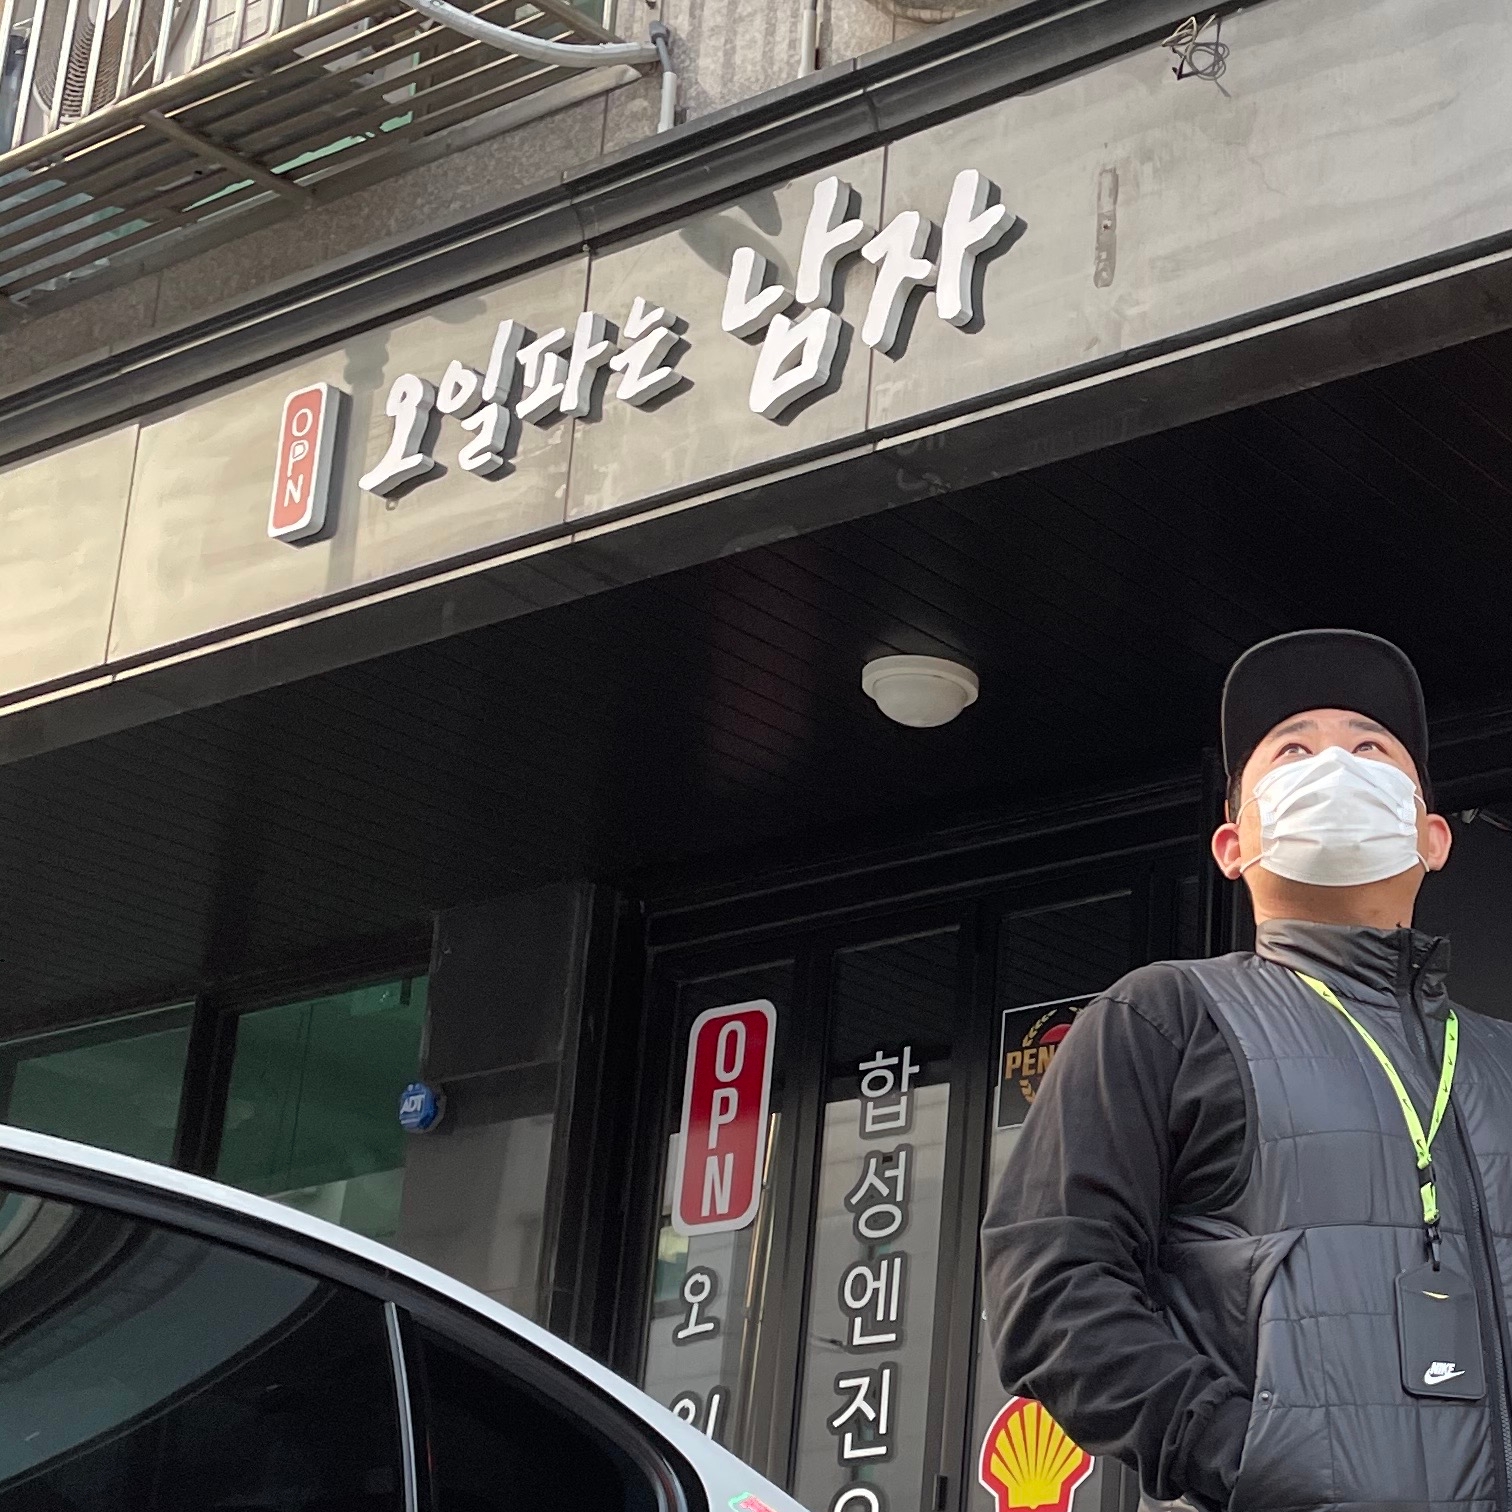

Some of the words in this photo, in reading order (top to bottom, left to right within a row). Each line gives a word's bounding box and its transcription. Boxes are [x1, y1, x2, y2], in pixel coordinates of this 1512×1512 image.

[721, 168, 1016, 422] 남자
[283, 407, 314, 508] OPN
[400, 1094, 426, 1114] ADT
[699, 1019, 747, 1218] OPN
[1429, 1361, 1456, 1375] NIKE
